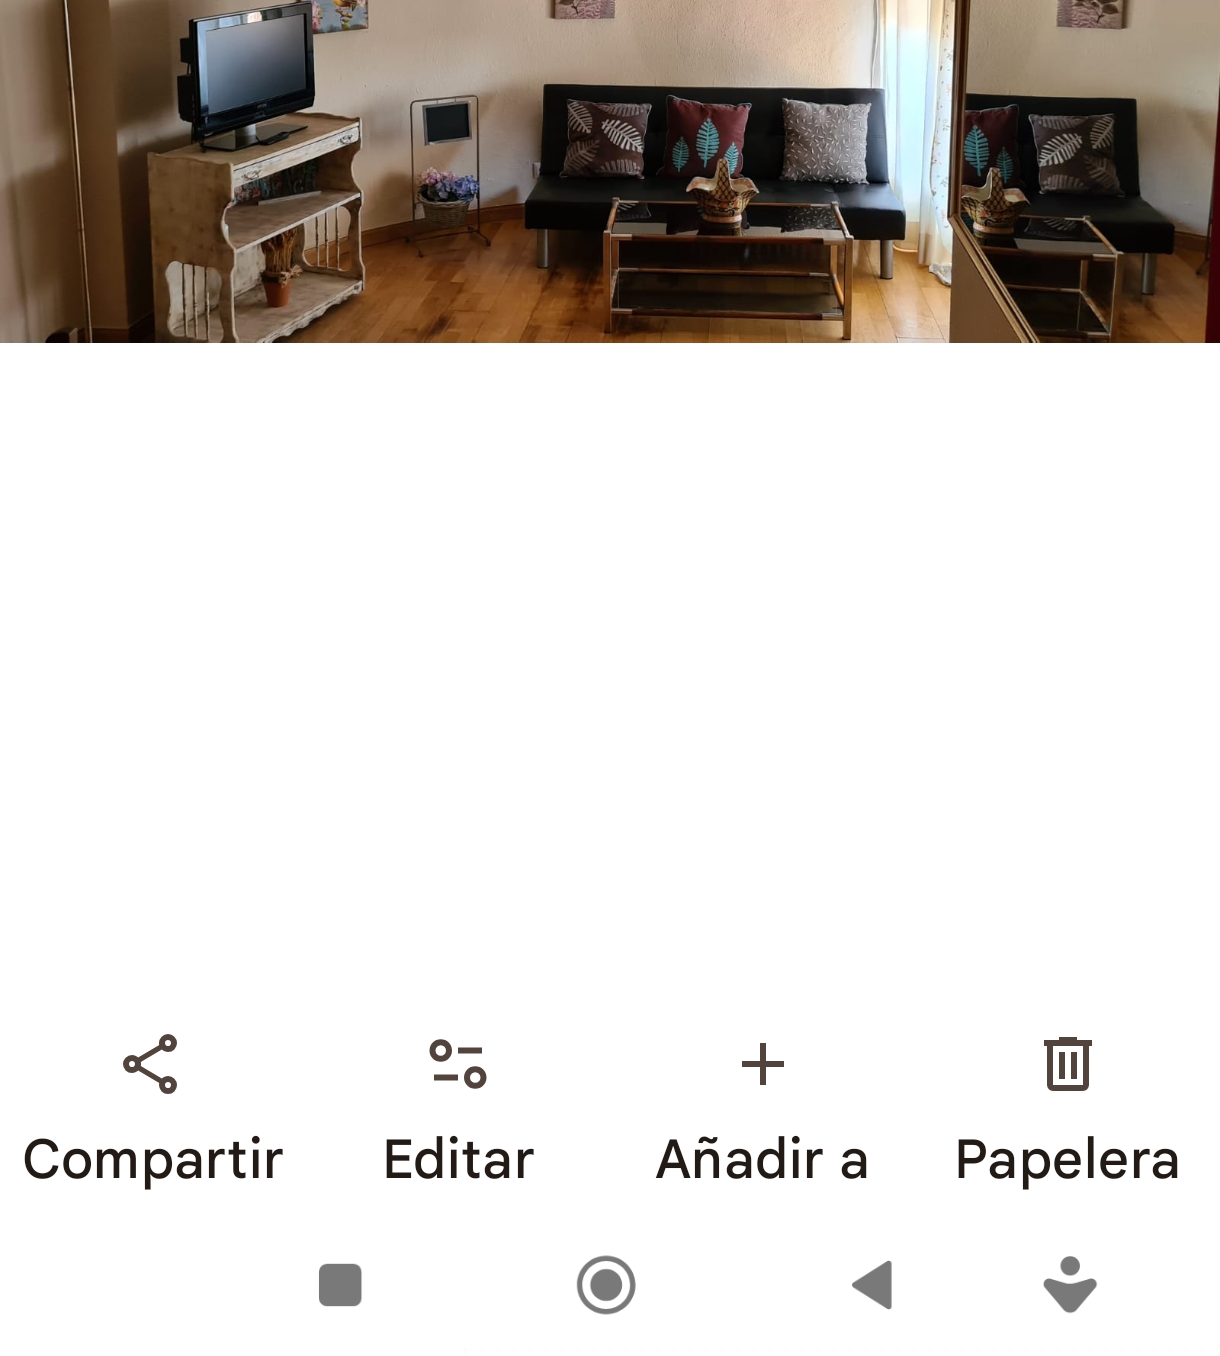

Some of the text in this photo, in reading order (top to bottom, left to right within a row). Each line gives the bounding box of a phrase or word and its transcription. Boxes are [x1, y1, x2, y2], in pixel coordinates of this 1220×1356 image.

[24, 1135, 284, 1191] Compartir
[386, 1135, 535, 1180] Editar
[655, 1135, 867, 1180] Añadir a
[958, 1135, 1178, 1191] Papelera
